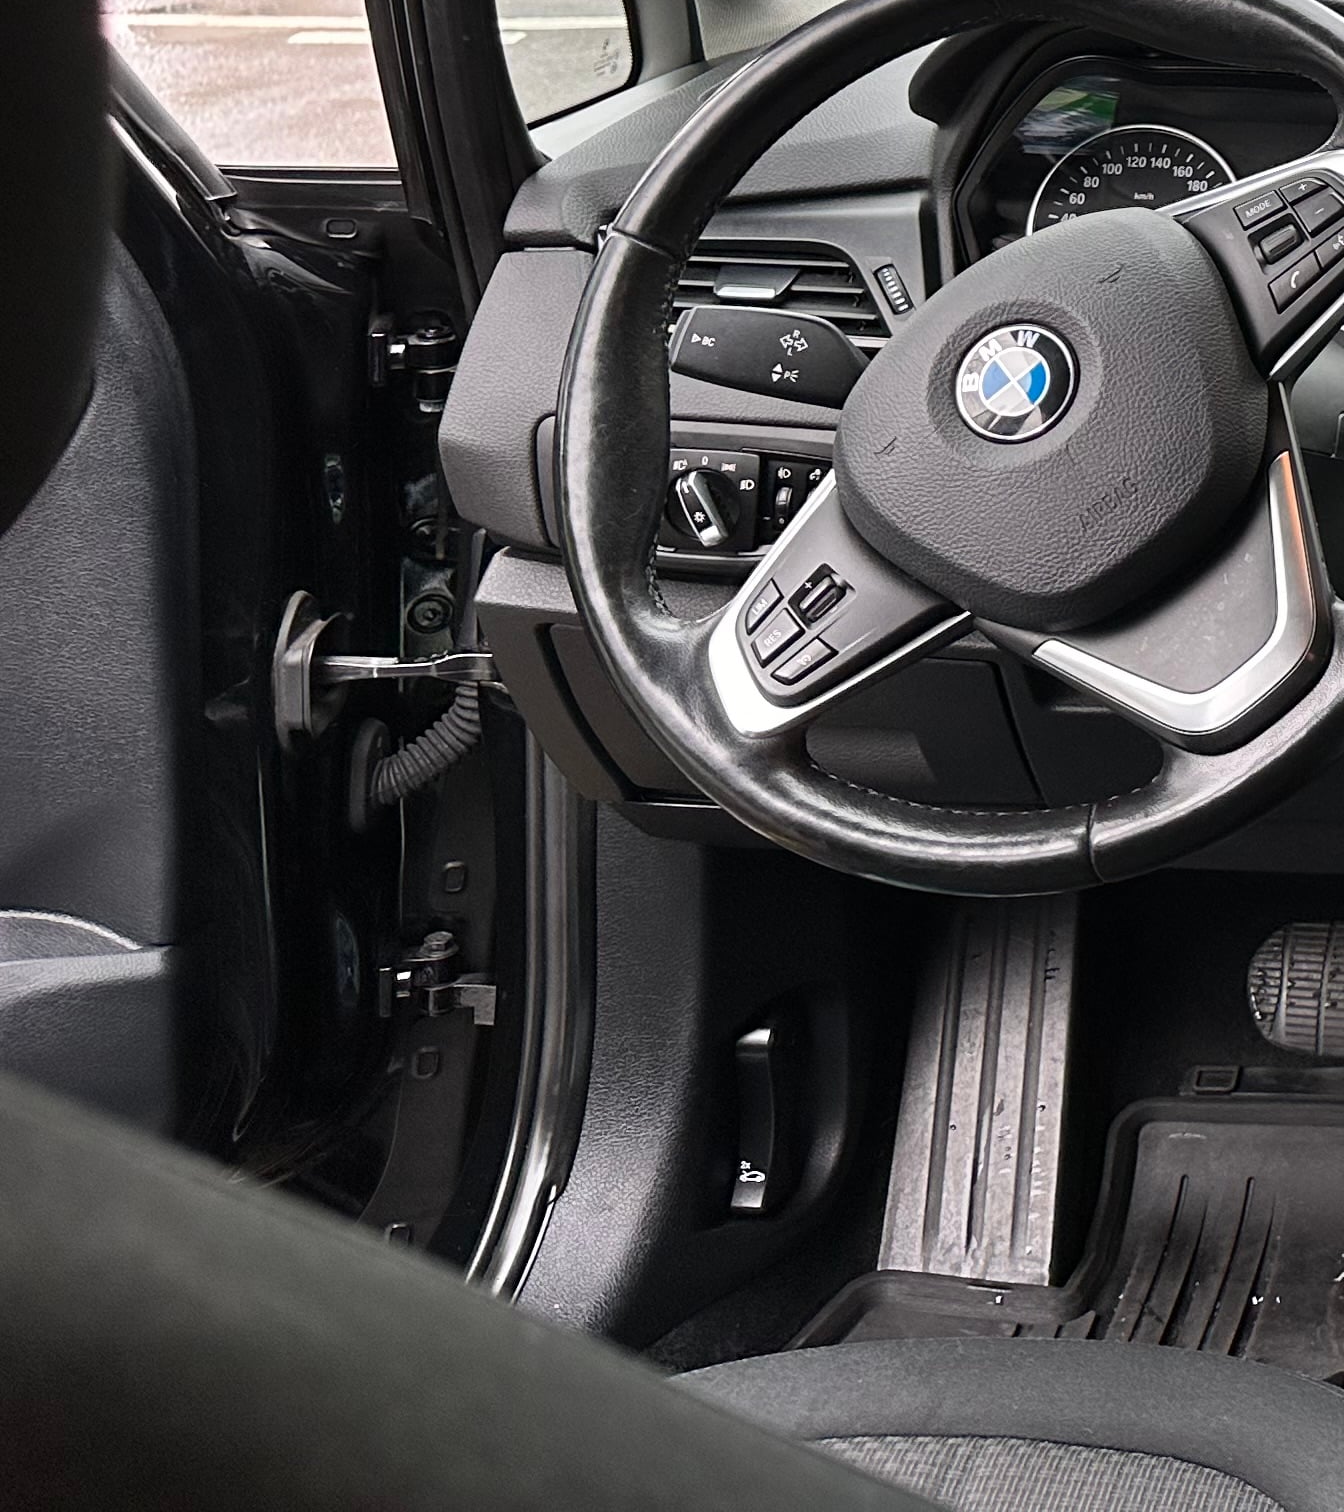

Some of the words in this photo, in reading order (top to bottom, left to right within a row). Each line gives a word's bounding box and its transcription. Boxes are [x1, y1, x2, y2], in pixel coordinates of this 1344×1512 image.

[1126, 156, 1147, 168] 120
[1150, 157, 1171, 169] 140
[1102, 163, 1123, 175] 100
[1172, 166, 1193, 178] 160
[1083, 176, 1100, 188] 80
[1186, 180, 1208, 192] 180
[1069, 192, 1086, 205] 60
[1245, 199, 1271, 219] MODE
[792, 329, 801, 339] R
[701, 336, 716, 347] BC
[787, 348, 793, 357] L
[962, 330, 1040, 392] BMW
[763, 629, 782, 647] RES
